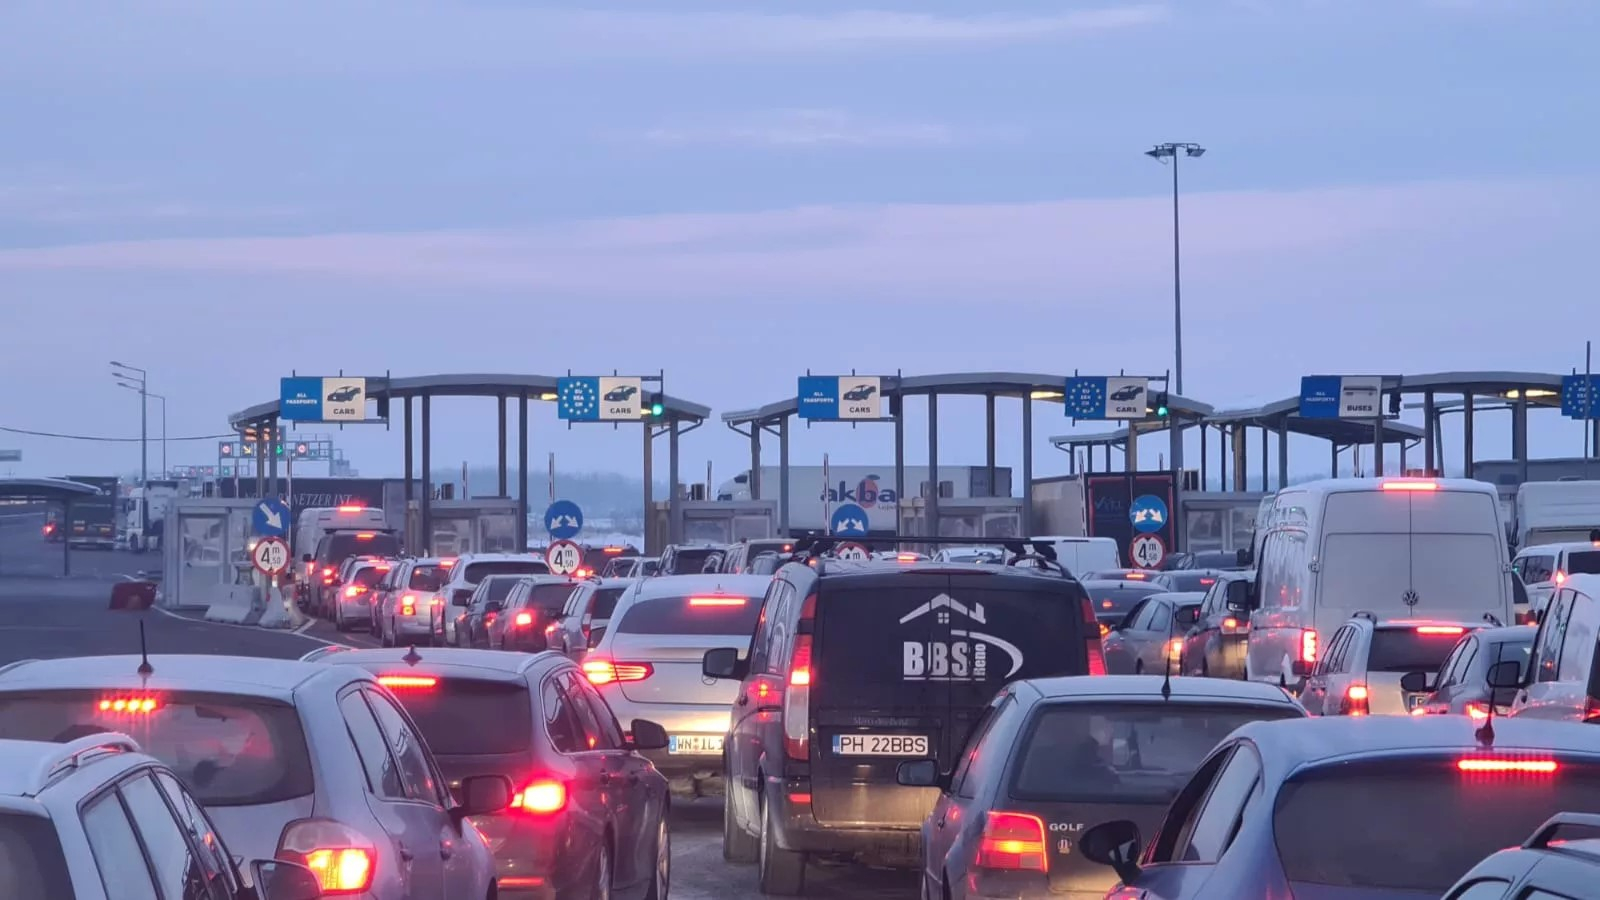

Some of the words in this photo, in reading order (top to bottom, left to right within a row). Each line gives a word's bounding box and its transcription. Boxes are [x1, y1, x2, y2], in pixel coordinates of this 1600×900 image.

[820, 480, 896, 502] akba
[261, 547, 270, 564] 4
[272, 546, 280, 554] m
[553, 550, 563, 567] 4
[565, 550, 573, 558] m
[1138, 543, 1147, 561] 4
[1149, 543, 1157, 551] m
[973, 643, 986, 676] Reno
[840, 736, 864, 753] PH
[871, 737, 926, 753] 22BBS
[1049, 822, 1085, 832] GOLF
